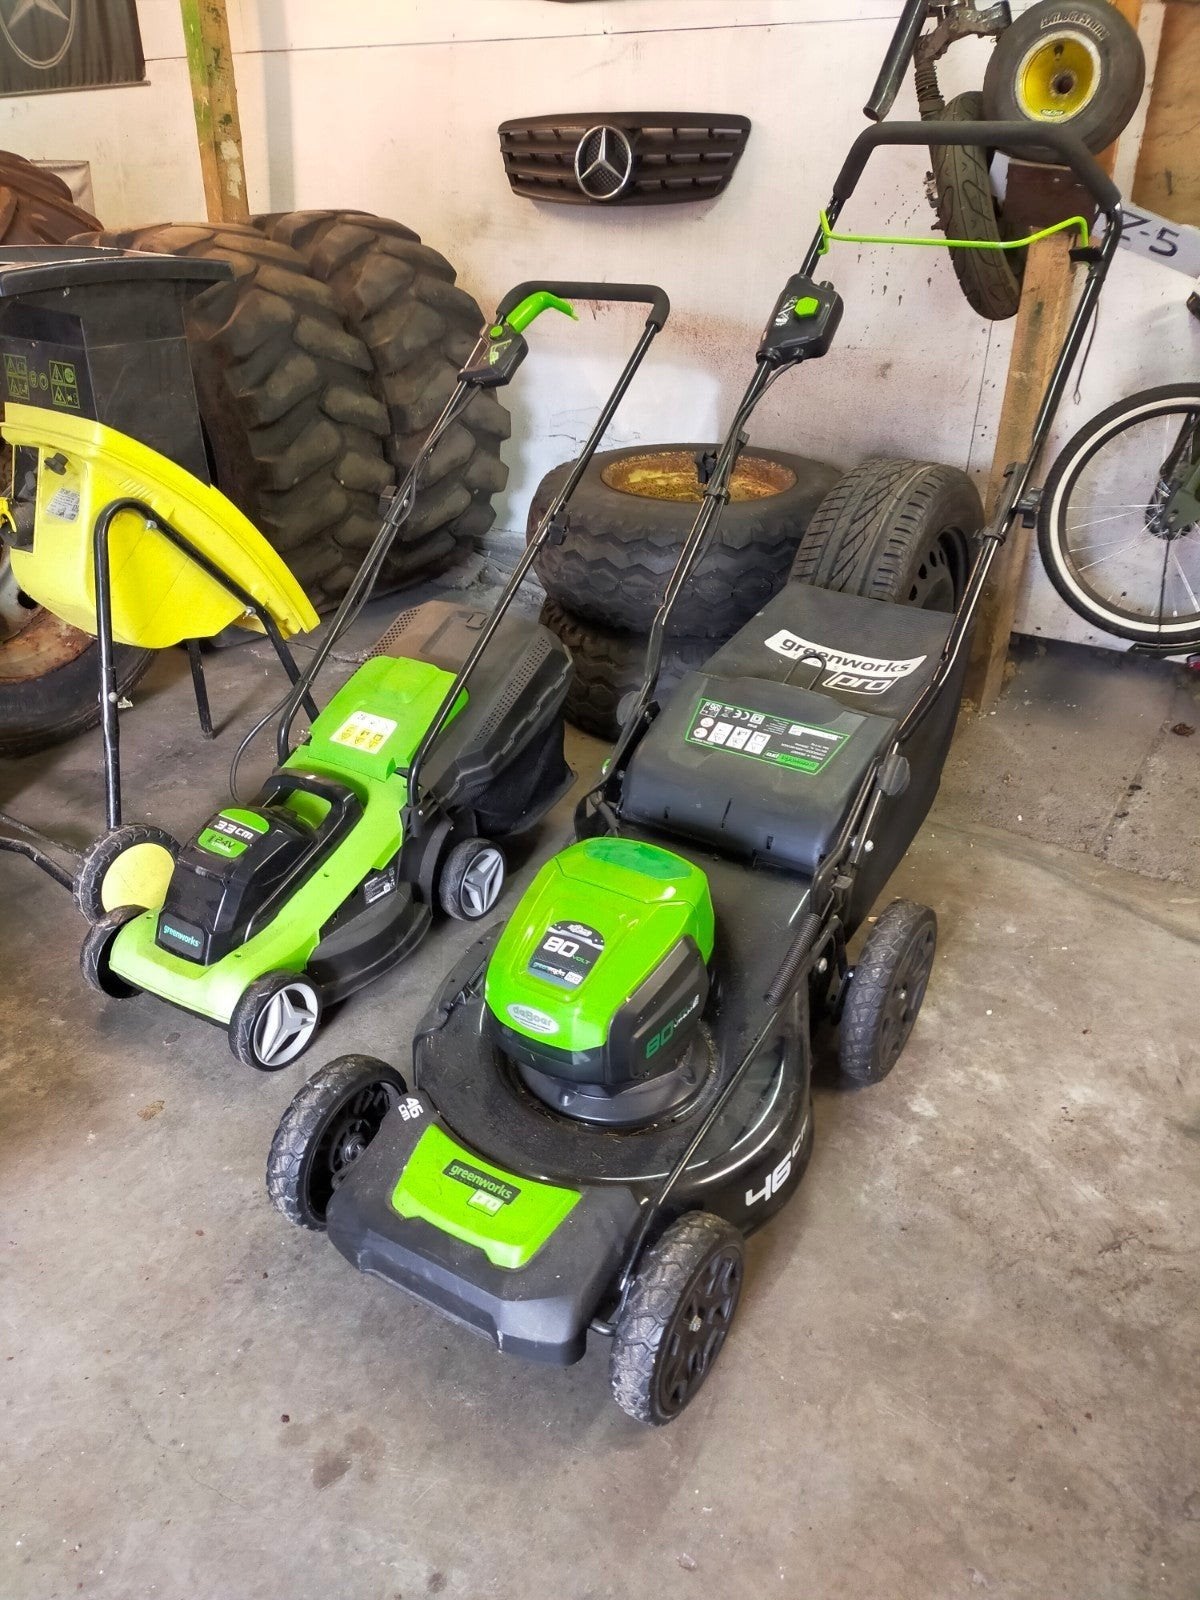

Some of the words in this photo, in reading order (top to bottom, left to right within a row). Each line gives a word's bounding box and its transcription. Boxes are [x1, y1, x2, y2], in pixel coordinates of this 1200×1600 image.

[779, 637, 912, 673] greenworks
[829, 674, 893, 691] pro
[163, 924, 199, 947] greenworks
[542, 935, 580, 958] 80
[572, 953, 592, 966] VOLT
[532, 961, 567, 977] greenworks
[645, 1019, 675, 1059] 80
[398, 1103, 411, 1121] cm
[405, 1097, 424, 1118] 46
[448, 1164, 513, 1199] greenworks
[745, 1150, 792, 1207] 46
